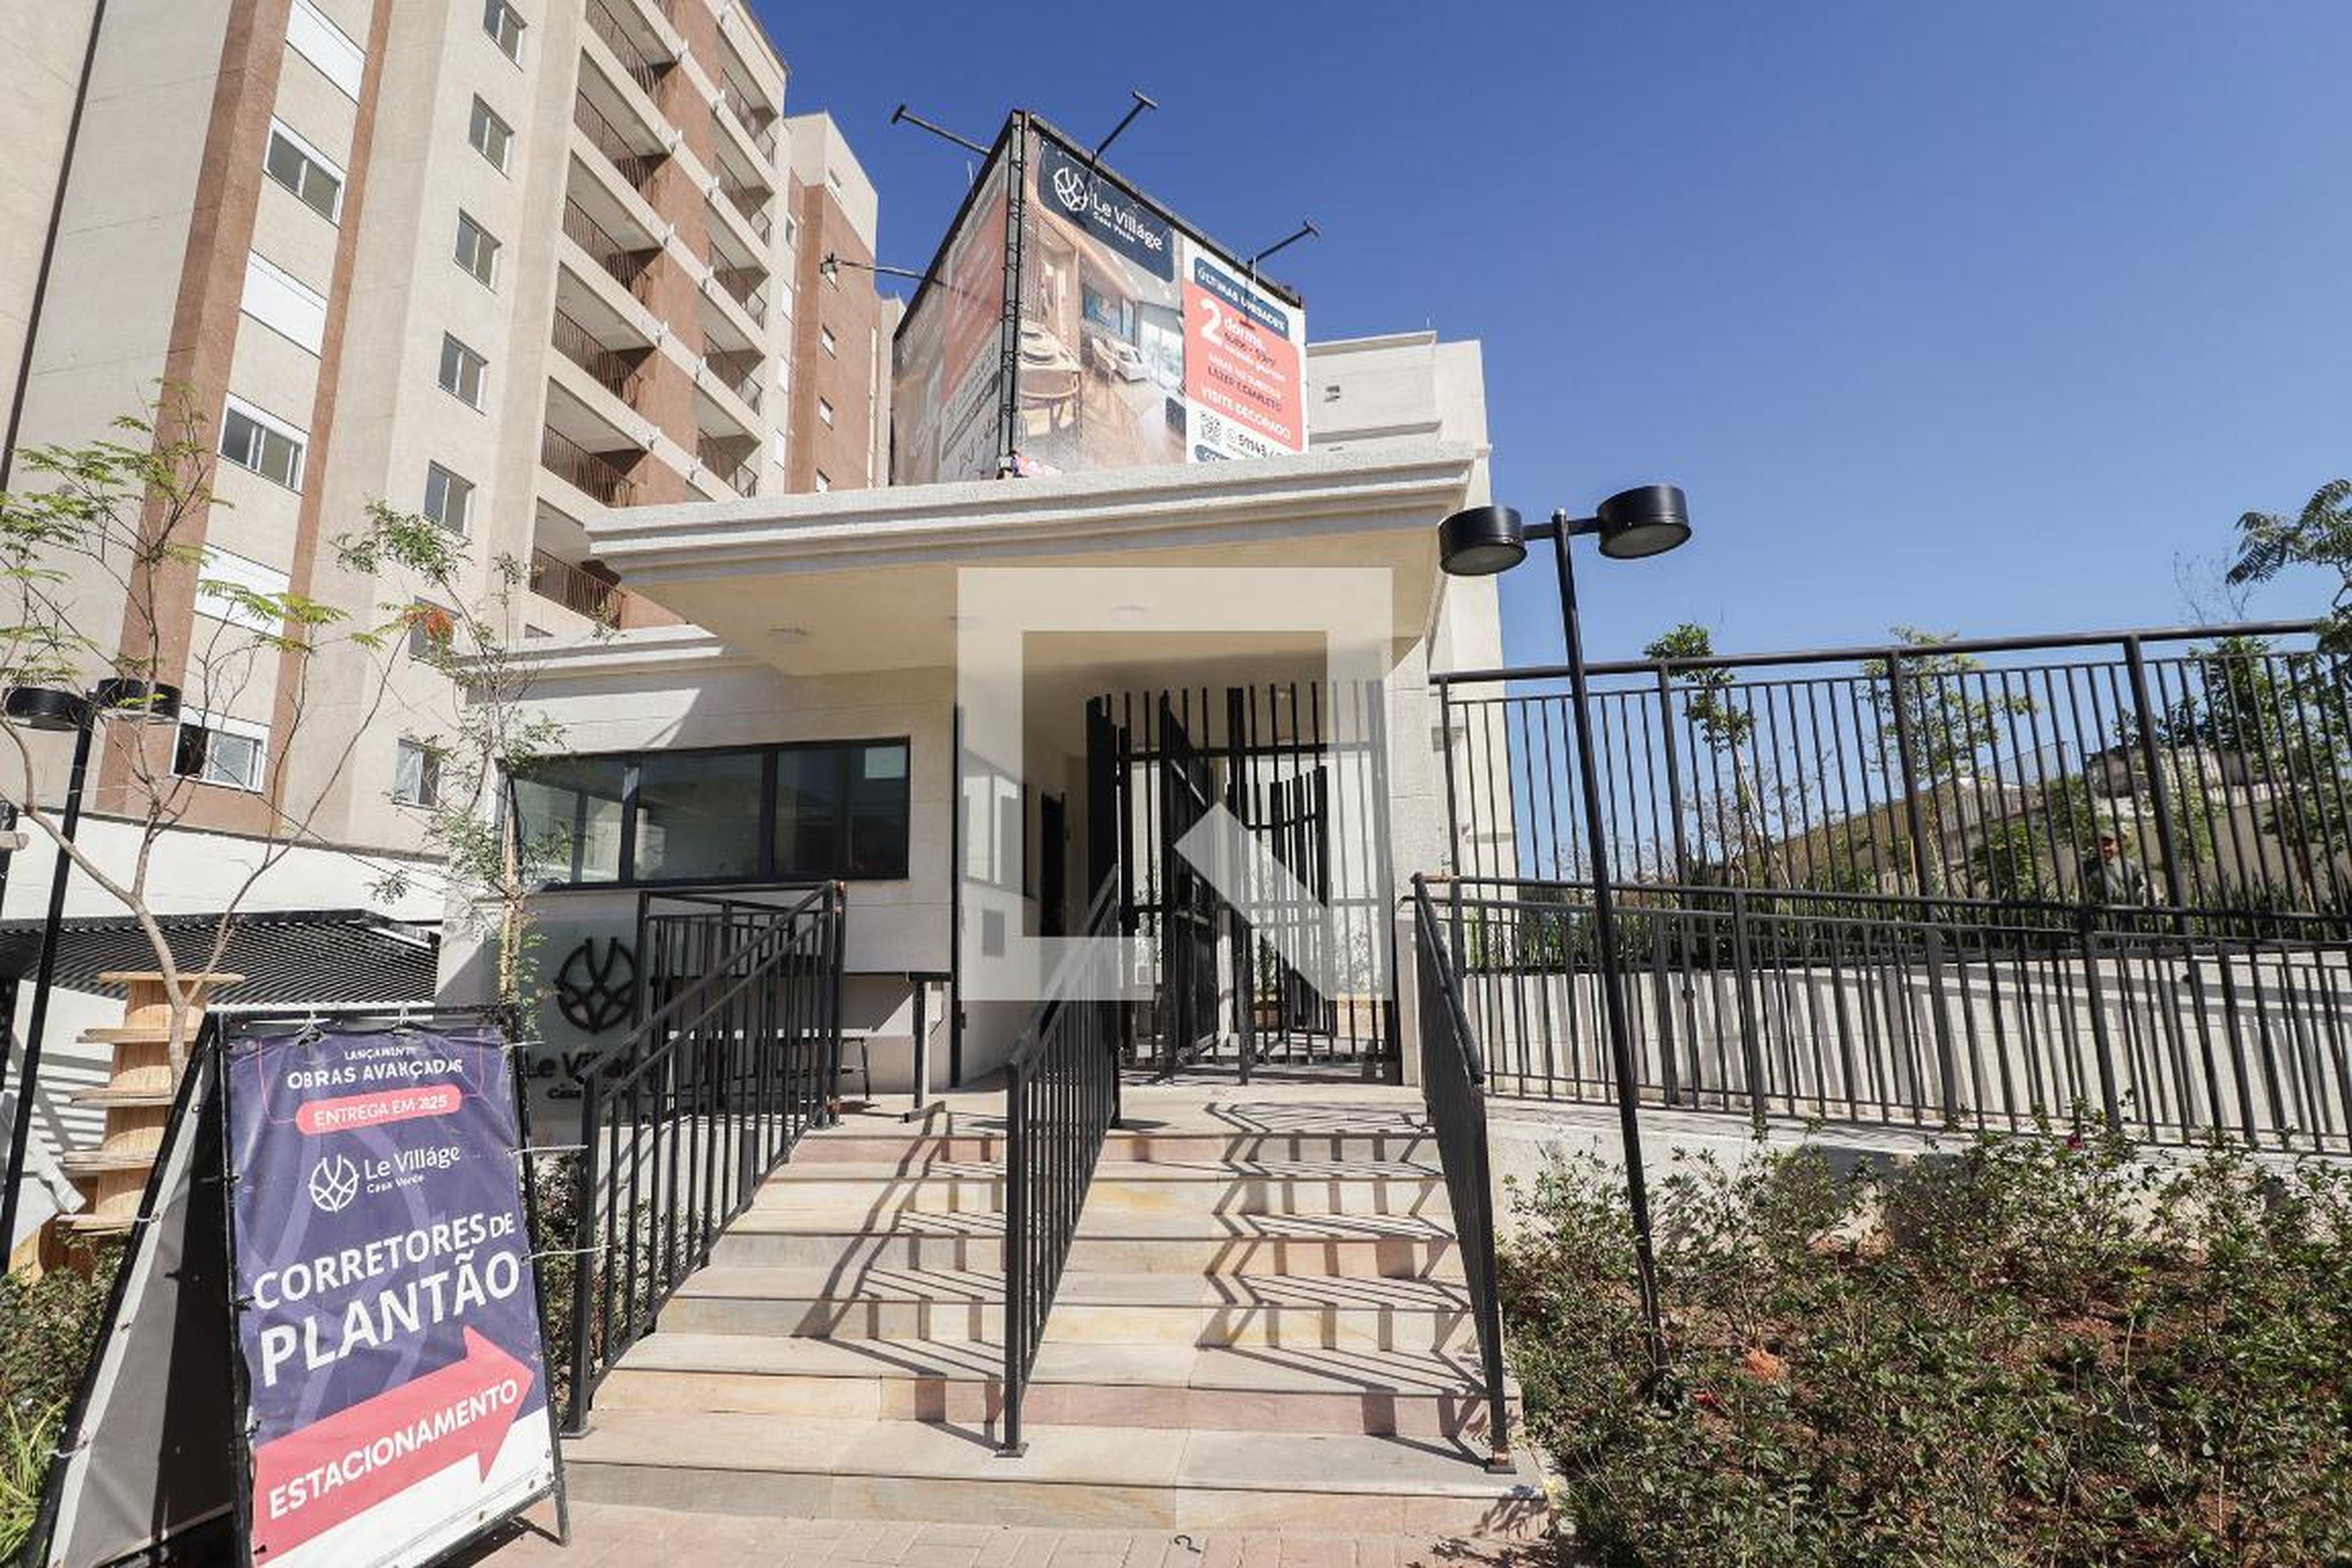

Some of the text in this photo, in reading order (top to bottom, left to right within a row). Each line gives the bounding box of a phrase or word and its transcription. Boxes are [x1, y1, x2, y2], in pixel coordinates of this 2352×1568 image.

[1093, 193, 1163, 252] Le Villáge
[1200, 298, 1223, 347] 2
[287, 1058, 464, 1090] OBRAS AVANÇADAS
[313, 1102, 389, 1128] ENTREGA
[391, 1100, 416, 1115] EM
[365, 1146, 461, 1181] Le Villáge
[366, 1182, 393, 1194] Casa
[254, 1212, 515, 1311] CORRETORES DE
[260, 1250, 520, 1388] PLANTÃO
[270, 1378, 518, 1520] ESTACIONAMENTO
